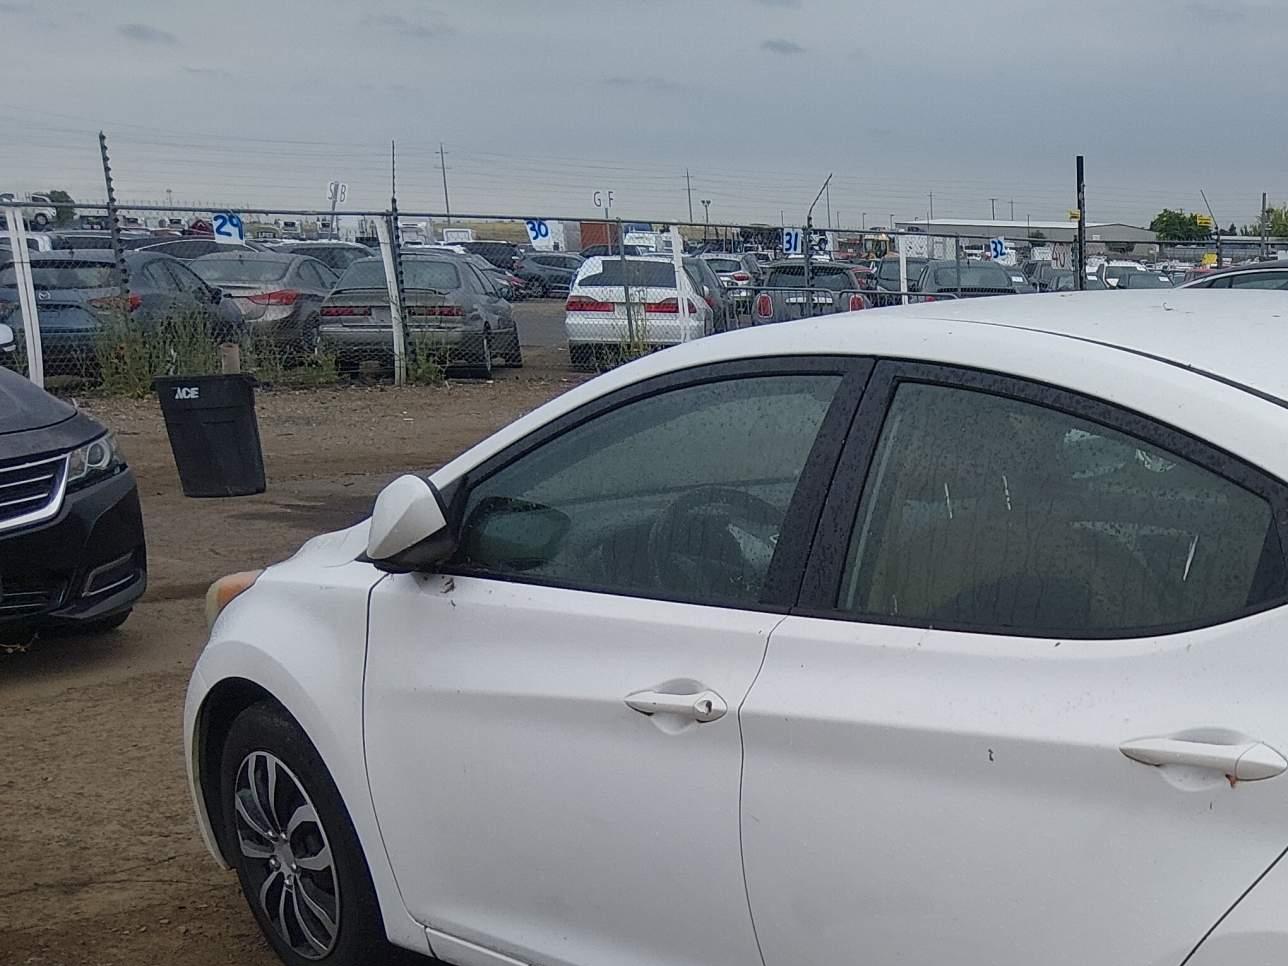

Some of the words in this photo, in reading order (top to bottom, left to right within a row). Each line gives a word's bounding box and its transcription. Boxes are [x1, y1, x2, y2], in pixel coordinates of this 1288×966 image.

[339, 184, 347, 202] B
[593, 191, 602, 207] G
[608, 191, 614, 208] F
[213, 213, 244, 241] 29
[526, 220, 549, 240] 30
[785, 231, 798, 252] 31
[991, 240, 1006, 259] 32
[175, 386, 199, 399] ACE
